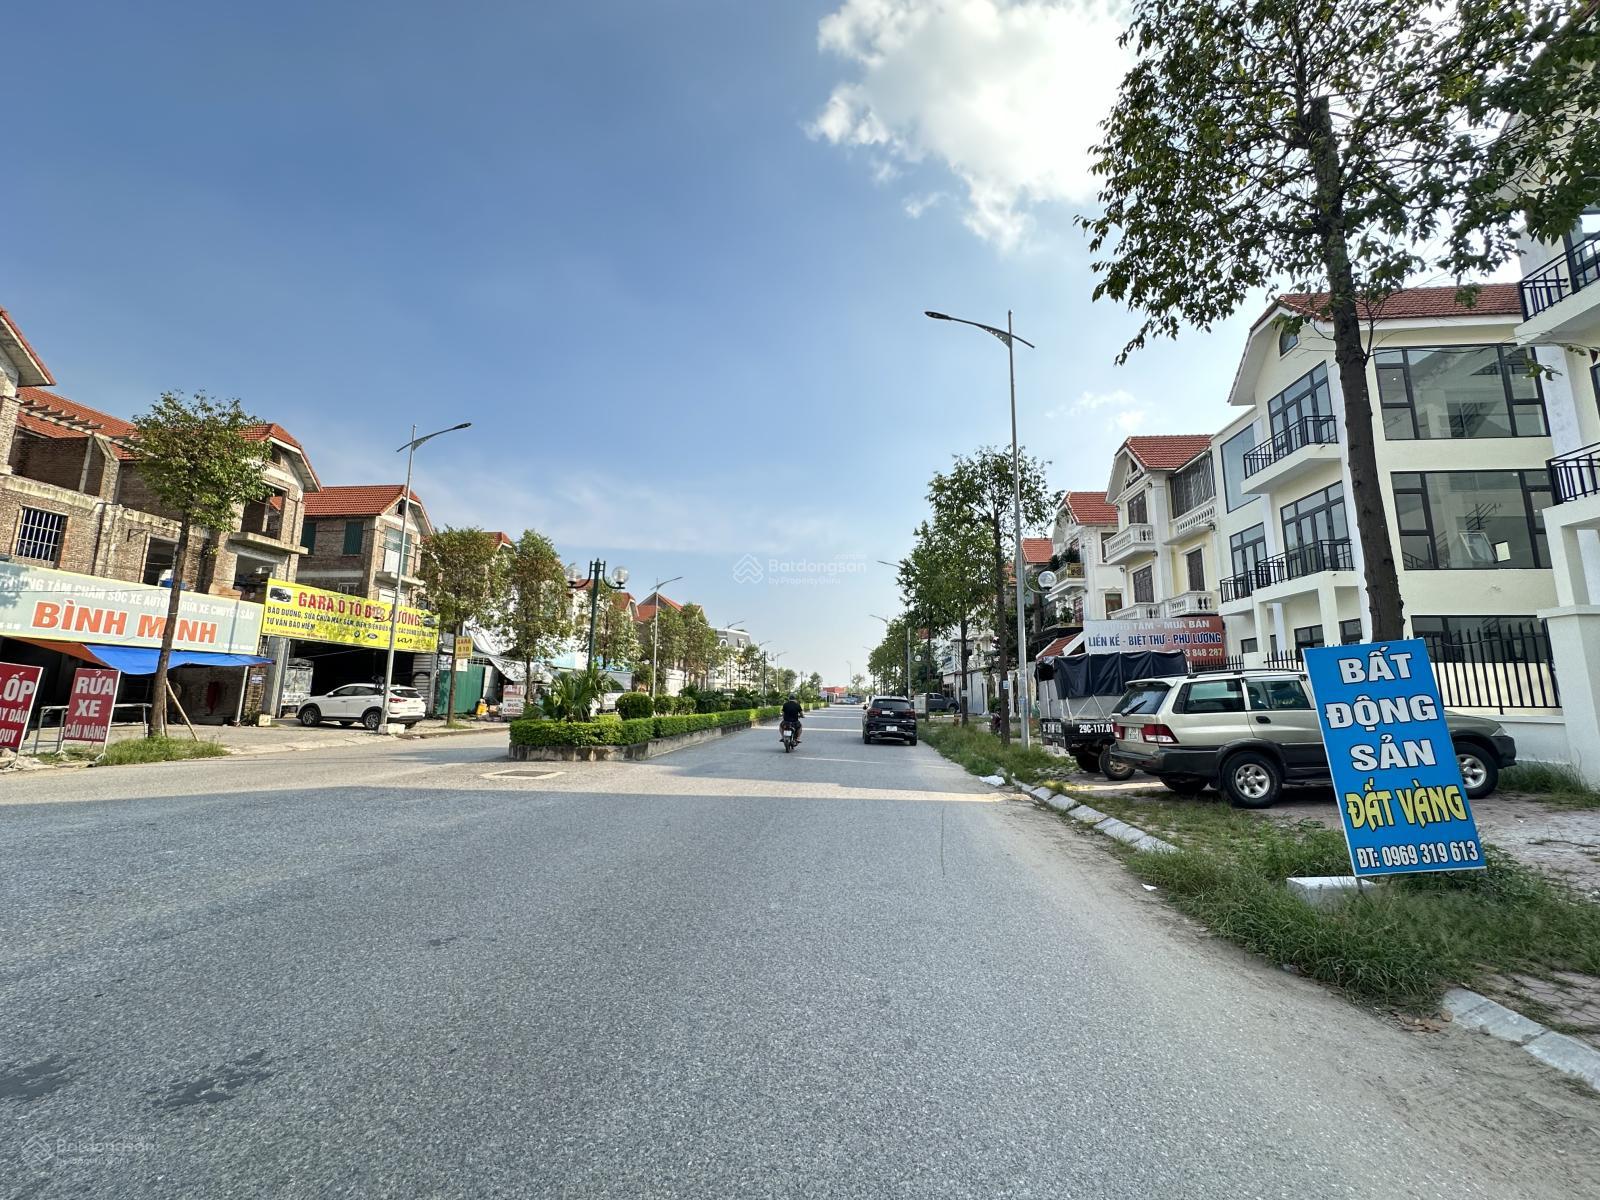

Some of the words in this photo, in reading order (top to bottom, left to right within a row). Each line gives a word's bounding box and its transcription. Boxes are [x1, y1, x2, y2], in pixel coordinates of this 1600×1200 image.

[129, 593, 143, 606] XE
[199, 602, 210, 614] XE
[298, 591, 334, 612] GARA
[338, 596, 346, 614] Ô
[349, 600, 362, 617] TÔ
[32, 598, 128, 636] BÌNH
[135, 612, 218, 644] MNH
[1163, 621, 1186, 629] MUA
[1188, 618, 1210, 628] BÁN
[1128, 633, 1146, 647] BIỆT
[1148, 634, 1166, 647] THỰ
[1193, 632, 1222, 644] LƯƠNG
[1192, 648, 1207, 657] 848
[1208, 648, 1222, 656] 287
[1338, 646, 1412, 684] BẤT
[0, 671, 35, 703] ỐP
[75, 670, 114, 696] RỬA
[75, 699, 102, 718] XE
[1325, 694, 1439, 732] ĐỘNG
[82, 722, 107, 740] NÂNG
[1350, 733, 1436, 771] SẢN
[1345, 777, 1395, 831] ĐẤT
[1396, 779, 1467, 828] VÀNG
[1356, 848, 1380, 868] ĐT:
[1382, 844, 1418, 868] 0969
[1422, 842, 1448, 864] 319
[1451, 840, 1479, 862] 613
